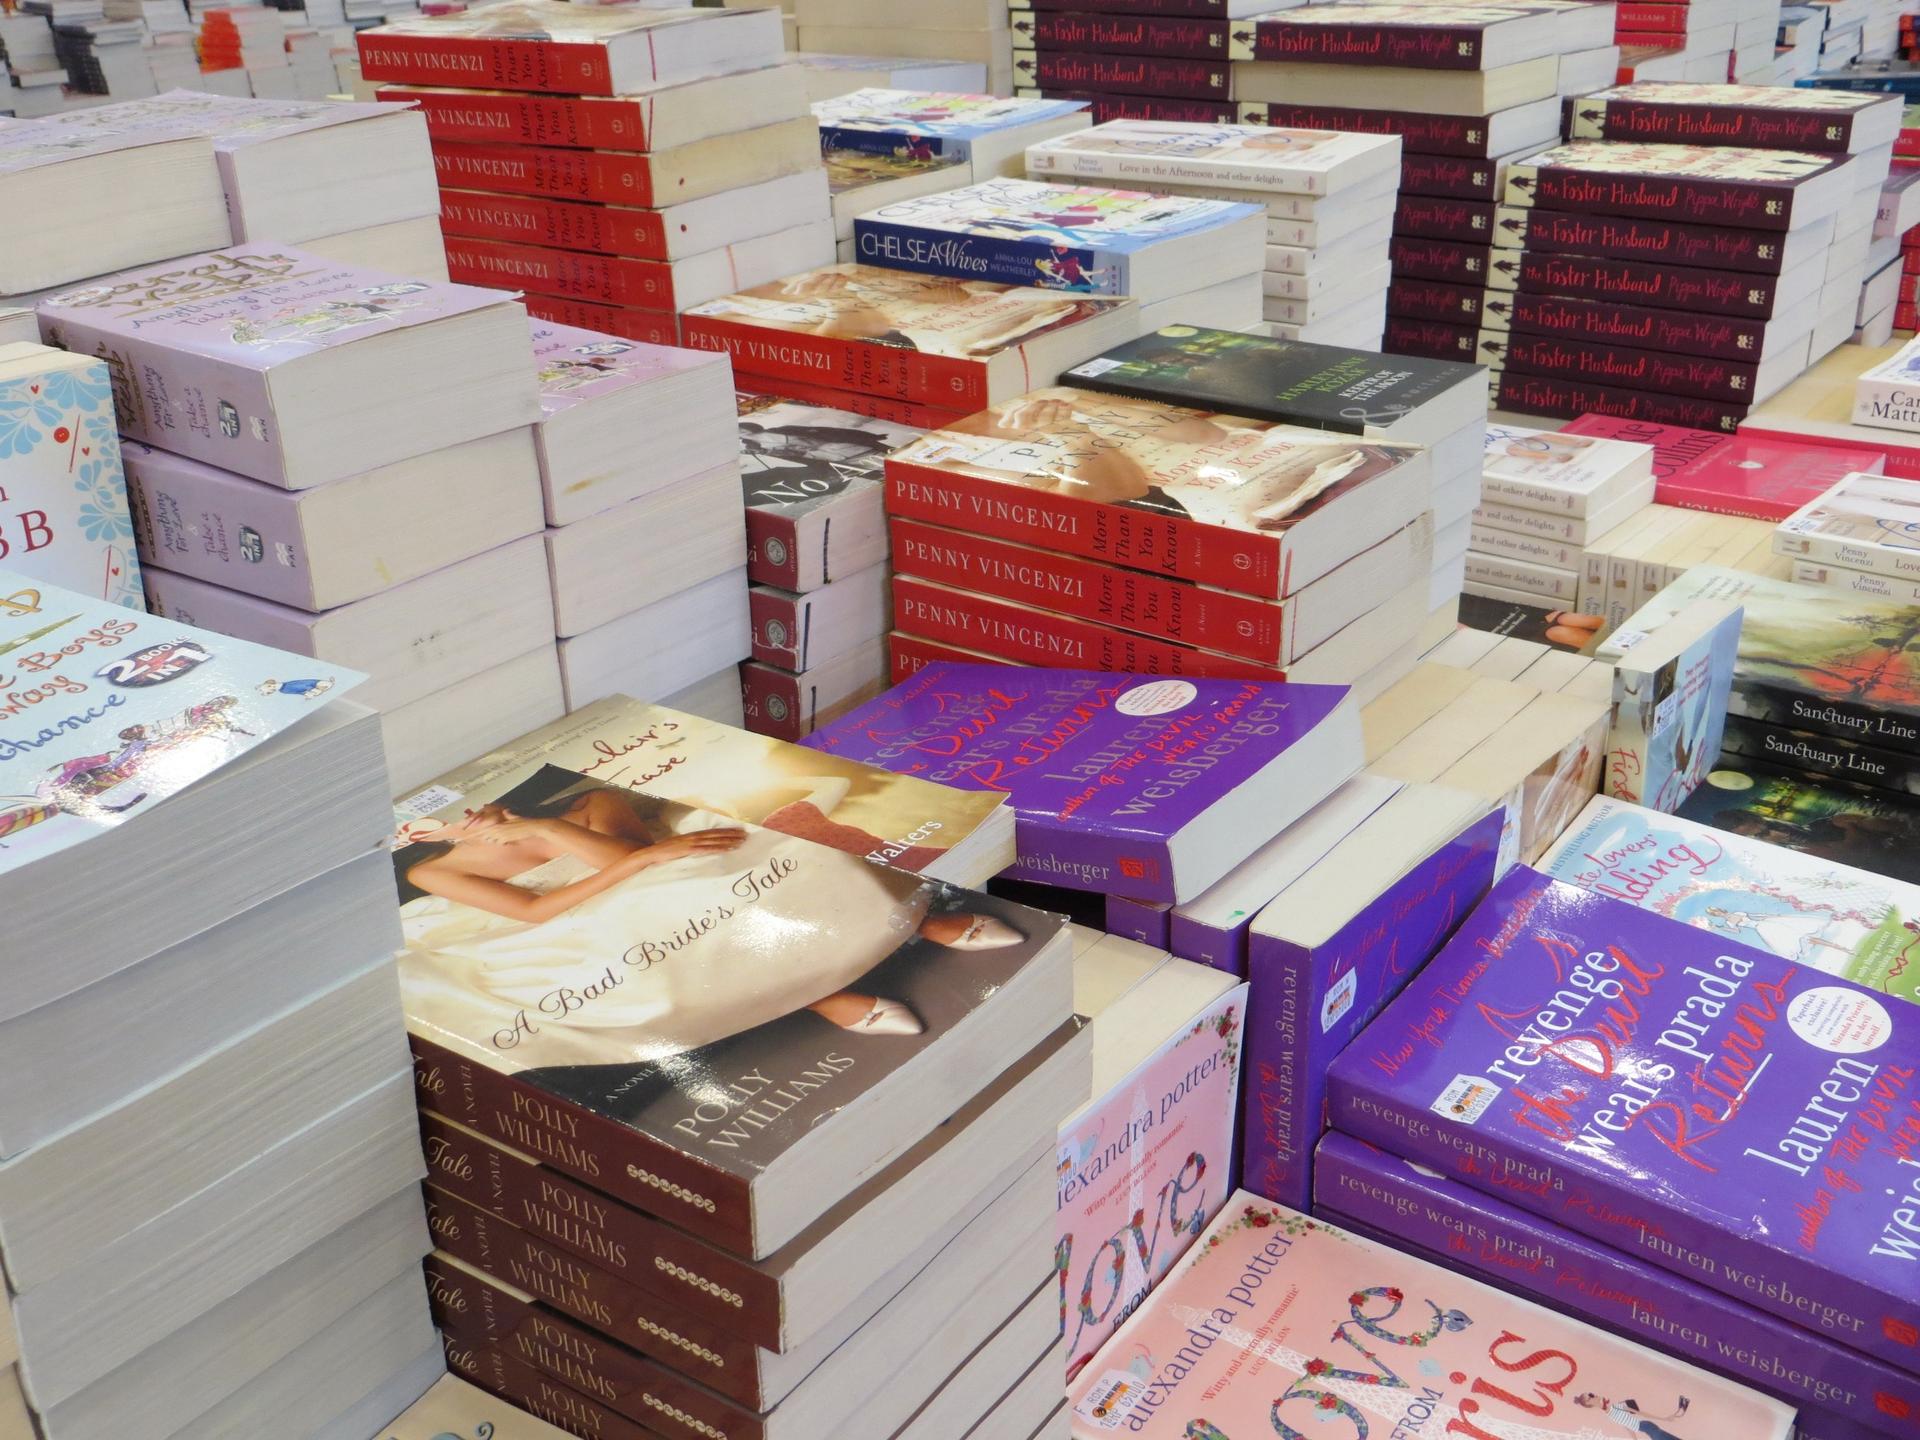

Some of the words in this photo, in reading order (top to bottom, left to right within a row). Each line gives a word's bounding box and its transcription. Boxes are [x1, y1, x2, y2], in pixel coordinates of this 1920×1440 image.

[366, 50, 409, 66] PENNY
[414, 53, 484, 72] VINCENZI
[439, 110, 511, 128] VINCENZI
[1629, 108, 1673, 132] Foster
[1678, 112, 1743, 135] Husband
[456, 157, 526, 178] VINCENZI
[1119, 163, 1140, 173] Love
[1152, 165, 1167, 176] the
[1169, 166, 1214, 180] Afternoon
[1216, 172, 1230, 181] and
[1233, 173, 1252, 183] other
[1254, 174, 1284, 187] delights
[1562, 175, 1607, 202] Foster
[1611, 181, 1679, 207] Husband
[467, 207, 537, 230] VINCENZI
[1552, 219, 1597, 244] Foster
[1602, 225, 1671, 250] Husband
[480, 256, 549, 279] VINCENZI
[861, 232, 941, 265] CHELSEA
[939, 239, 988, 272] Wives
[1546, 261, 1591, 286] Foster
[1595, 268, 1663, 294] Husband
[1538, 303, 1582, 327] Foster
[1586, 310, 1653, 338] Husband
[689, 331, 742, 355] PENNY
[750, 341, 832, 371] VINCENZI
[1532, 342, 1575, 368] Foster
[1580, 350, 1647, 377] Husband
[1144, 456, 1208, 487] More
[896, 481, 963, 511] PENNY
[971, 497, 1079, 536] VINCENZI
[1095, 509, 1110, 555] More
[1115, 513, 1131, 562] Than
[1138, 525, 1154, 559] You
[1163, 520, 1180, 573] Know
[1835, 552, 1873, 567] Vincenzi
[1842, 545, 1868, 558] Penny
[905, 539, 971, 571] PENNY
[978, 557, 1084, 597] VINCENZI
[1852, 581, 1892, 596] Vincenzi
[1859, 575, 1887, 588] Penny
[1098, 573, 1114, 618] More
[1120, 578, 1135, 624] Than
[1143, 589, 1159, 624] You
[1166, 585, 1183, 640] Know
[16, 619, 138, 673] Boys
[140, 634, 193, 661] BOOKS
[904, 599, 971, 630] PENNY
[978, 617, 1084, 659] VINCENZI
[1793, 700, 1873, 734] Sanctuary
[1877, 718, 1917, 740] Line
[1042, 714, 1176, 784] lauren
[1110, 697, 1291, 817] weisberger
[1765, 735, 1844, 769] Sanctuary
[1848, 754, 1886, 776] Line
[1588, 804, 1615, 834] AUTHOR
[1014, 850, 1110, 883] weisberger
[1584, 833, 1658, 871] Lovers'
[537, 966, 624, 1020] Bad
[621, 903, 734, 973] Bride's
[730, 853, 800, 908] Tale
[1274, 966, 1297, 1046] revenge
[1407, 1004, 1449, 1050] York
[1486, 950, 1620, 1087] revenge
[1279, 1049, 1296, 1105] wears
[1563, 1054, 1677, 1158] wears
[1654, 950, 1757, 1069] prada
[513, 1091, 580, 1138] POLLY
[673, 1068, 774, 1137] POLLY
[706, 1051, 857, 1153] WILLIAMS
[1743, 1056, 1881, 1177] lauren
[1857, 1063, 1916, 1132] DEVIL
[495, 1110, 600, 1177] WILLIAMS
[1057, 1109, 1153, 1212] lexandra
[1159, 1048, 1223, 1126] potter
[1273, 1105, 1297, 1162] prada
[1350, 1090, 1432, 1144] revenge
[1434, 1122, 1498, 1164] wears
[1504, 1152, 1566, 1192] prada
[426, 1136, 475, 1182] Tale
[542, 1180, 608, 1230] POLLY
[1338, 1168, 1420, 1217] revenge
[1424, 1199, 1488, 1241] wears
[1494, 1228, 1556, 1271] prada
[524, 1200, 628, 1268] WILLIAMS
[526, 1243, 591, 1291] POLLY
[1637, 1223, 1716, 1274] lauren
[1723, 1262, 1866, 1334] weisberger
[510, 1259, 612, 1326] WILLIAMS
[1112, 1279, 1153, 1333] FROM
[533, 1317, 597, 1366] POLLY
[1121, 1303, 1237, 1433] alexandra
[1225, 1228, 1296, 1309] potter
[1630, 1300, 1709, 1349] lauren
[1715, 1338, 1857, 1407] weisberger
[515, 1332, 617, 1401] WILLIAMS
[1225, 1359, 1242, 1377] and
[541, 1383, 603, 1431] POLLY
